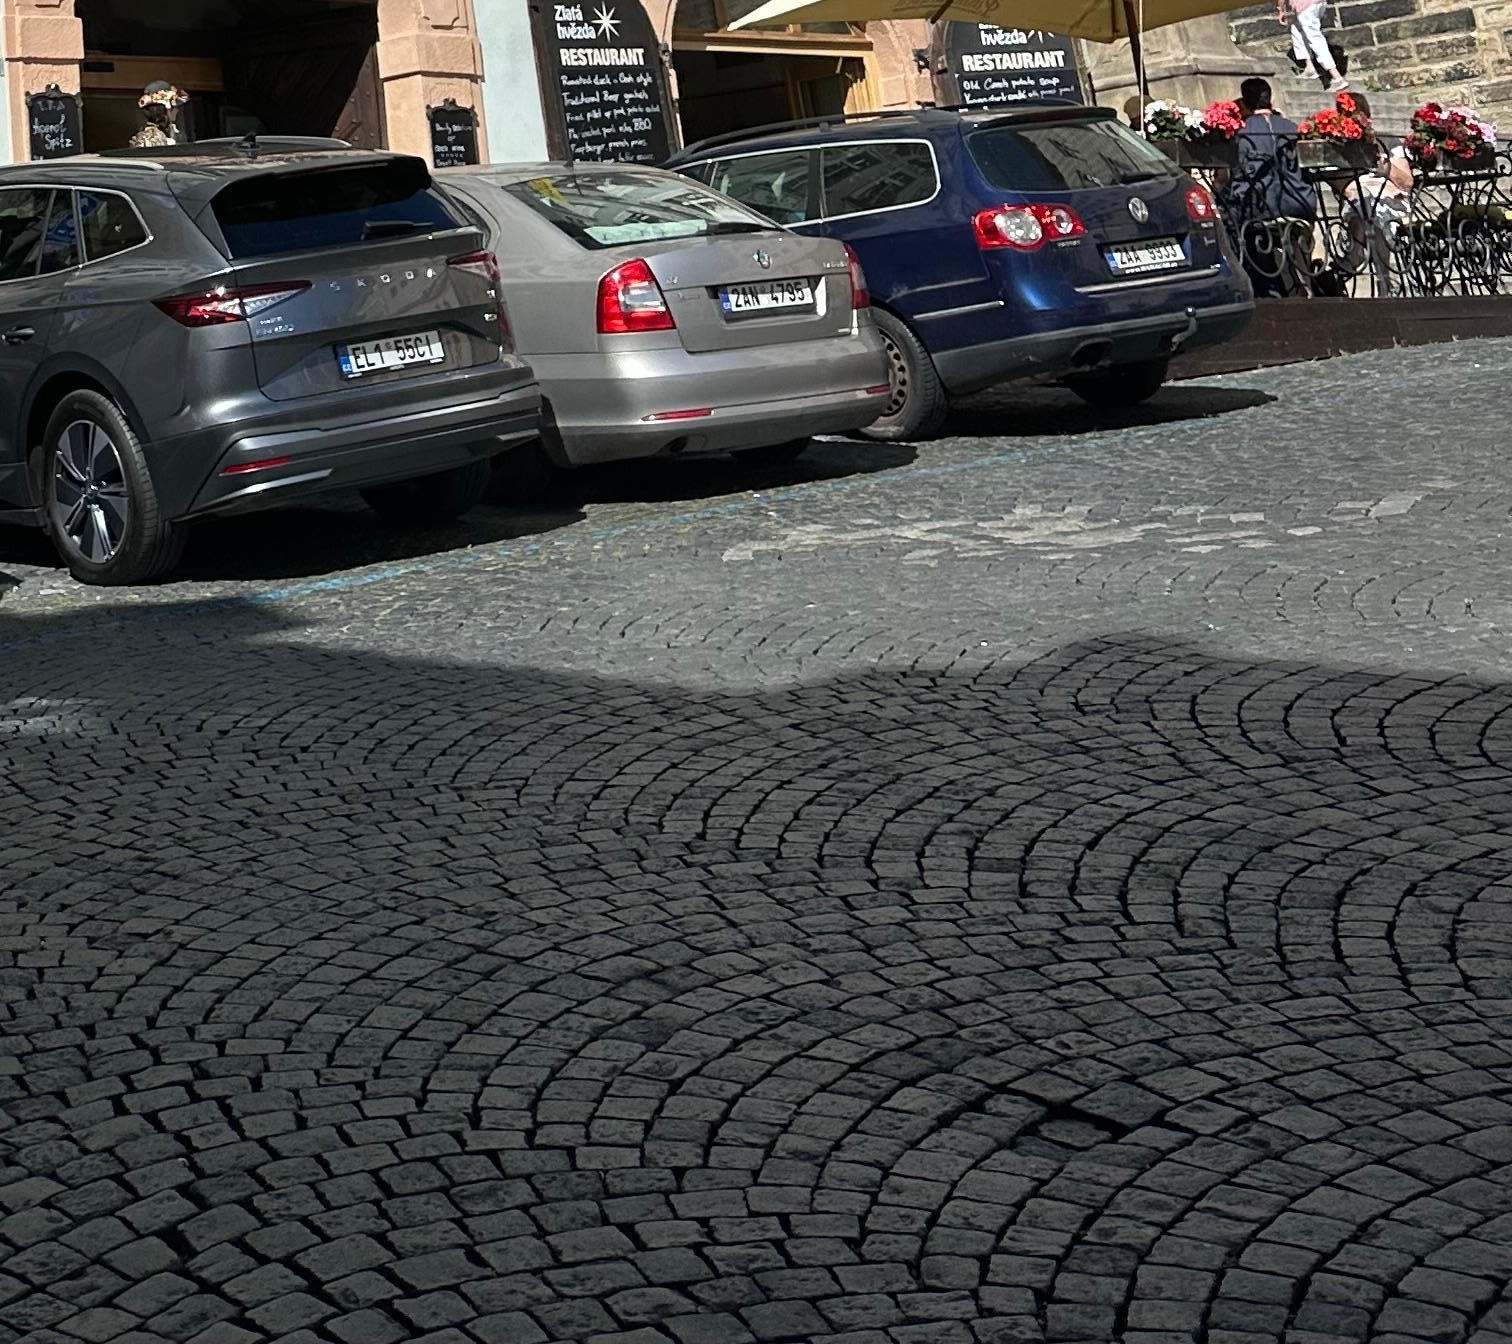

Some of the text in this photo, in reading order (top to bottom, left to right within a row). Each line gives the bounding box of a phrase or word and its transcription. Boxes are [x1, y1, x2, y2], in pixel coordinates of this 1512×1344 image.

[554, 4, 583, 21] Zlatá
[556, 22, 596, 40] hvězda
[980, 29, 1028, 46] hvězda
[559, 48, 645, 67] RESTAURANT
[962, 50, 1065, 72] RESTAURANT
[734, 284, 760, 309] 2AN
[770, 282, 805, 305] 4795
[351, 342, 386, 370] EL1
